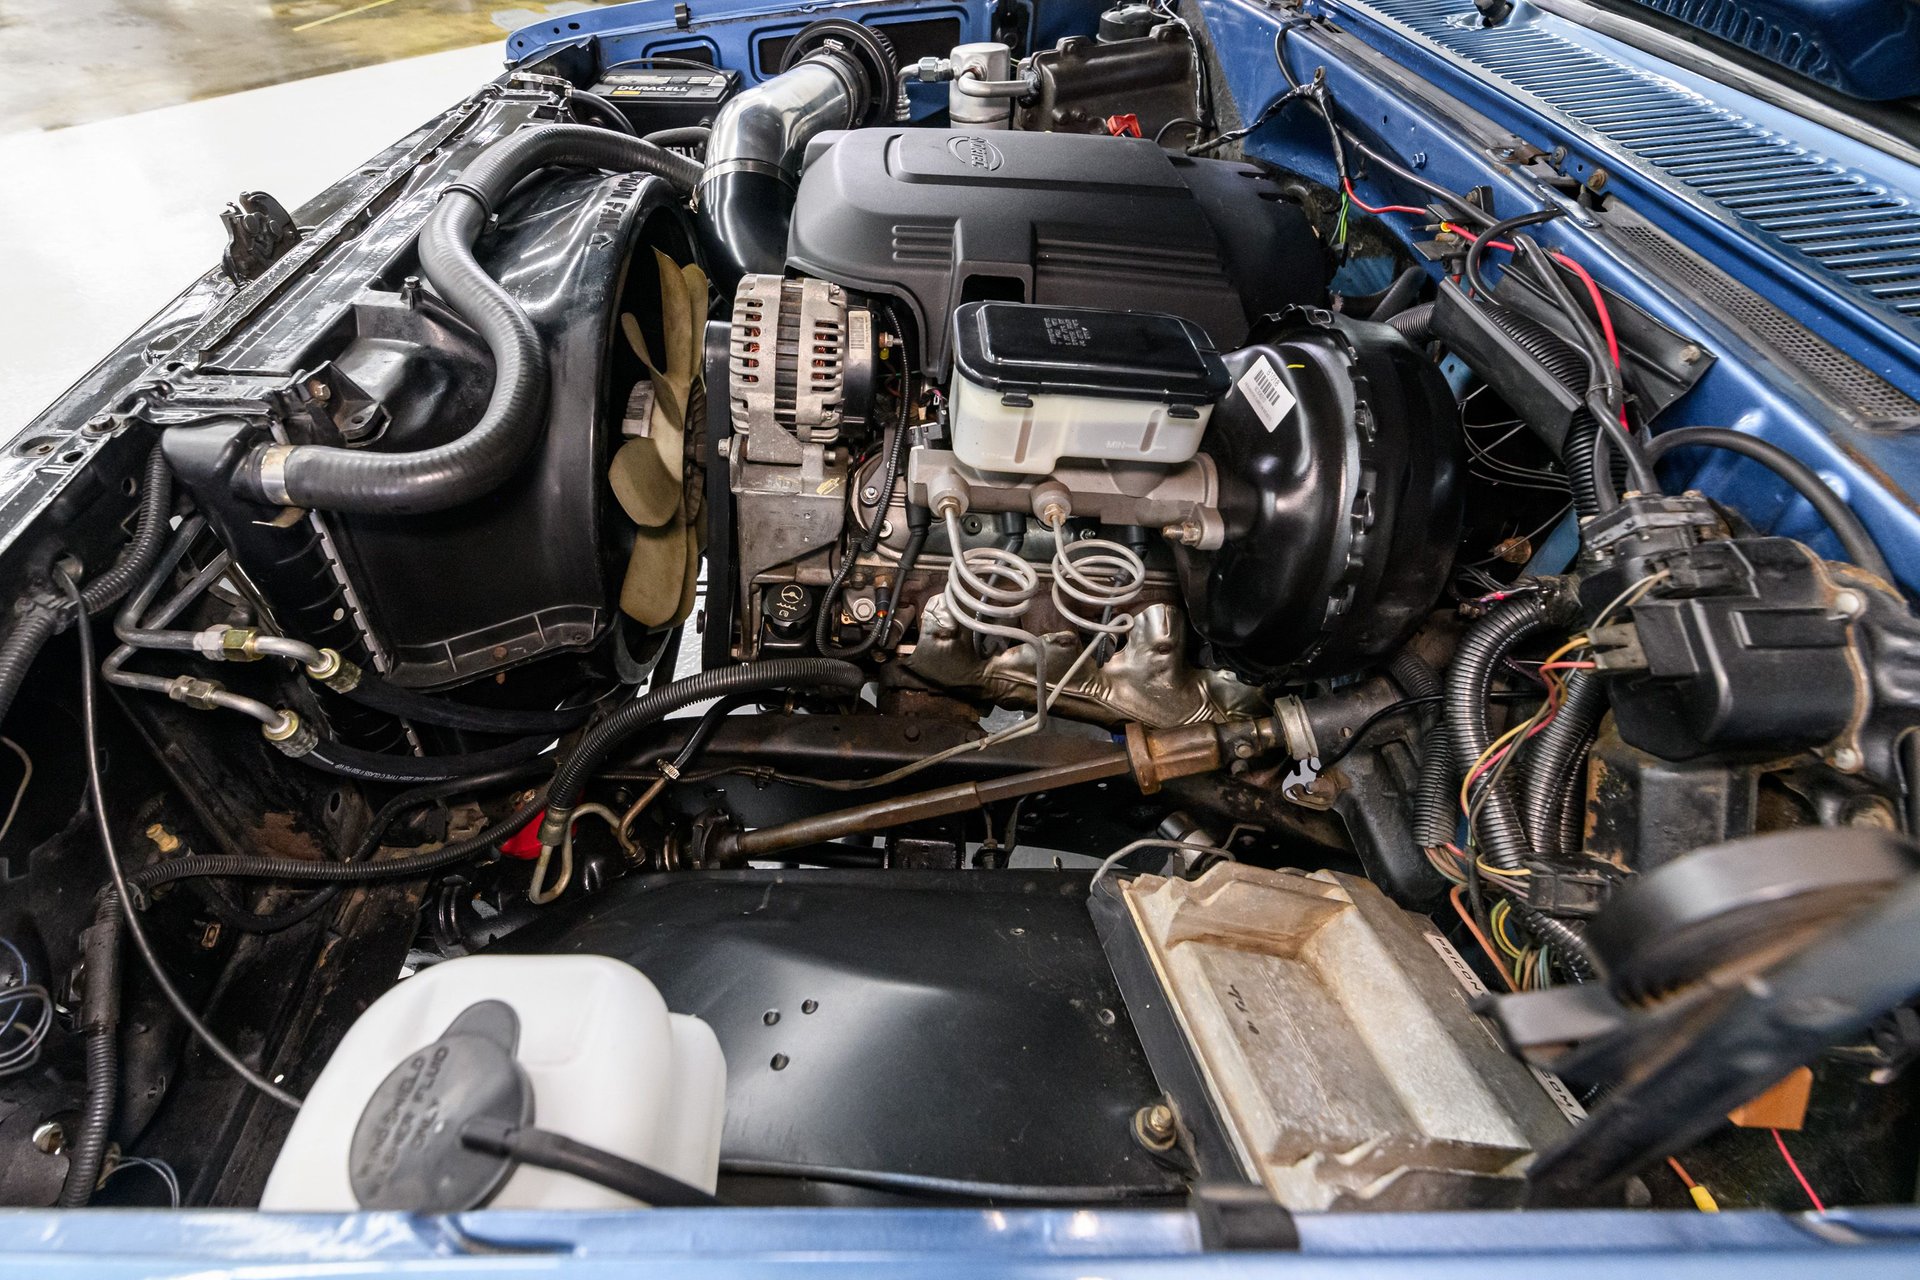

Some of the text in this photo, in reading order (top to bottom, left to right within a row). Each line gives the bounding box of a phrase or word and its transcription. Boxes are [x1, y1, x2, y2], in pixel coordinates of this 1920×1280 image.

[617, 85, 689, 93] DURACELL
[1105, 440, 1126, 449] MIN
[363, 770, 381, 778] CLASS
[1436, 937, 1484, 995] PSICON
[411, 1046, 450, 1103] FLUID
